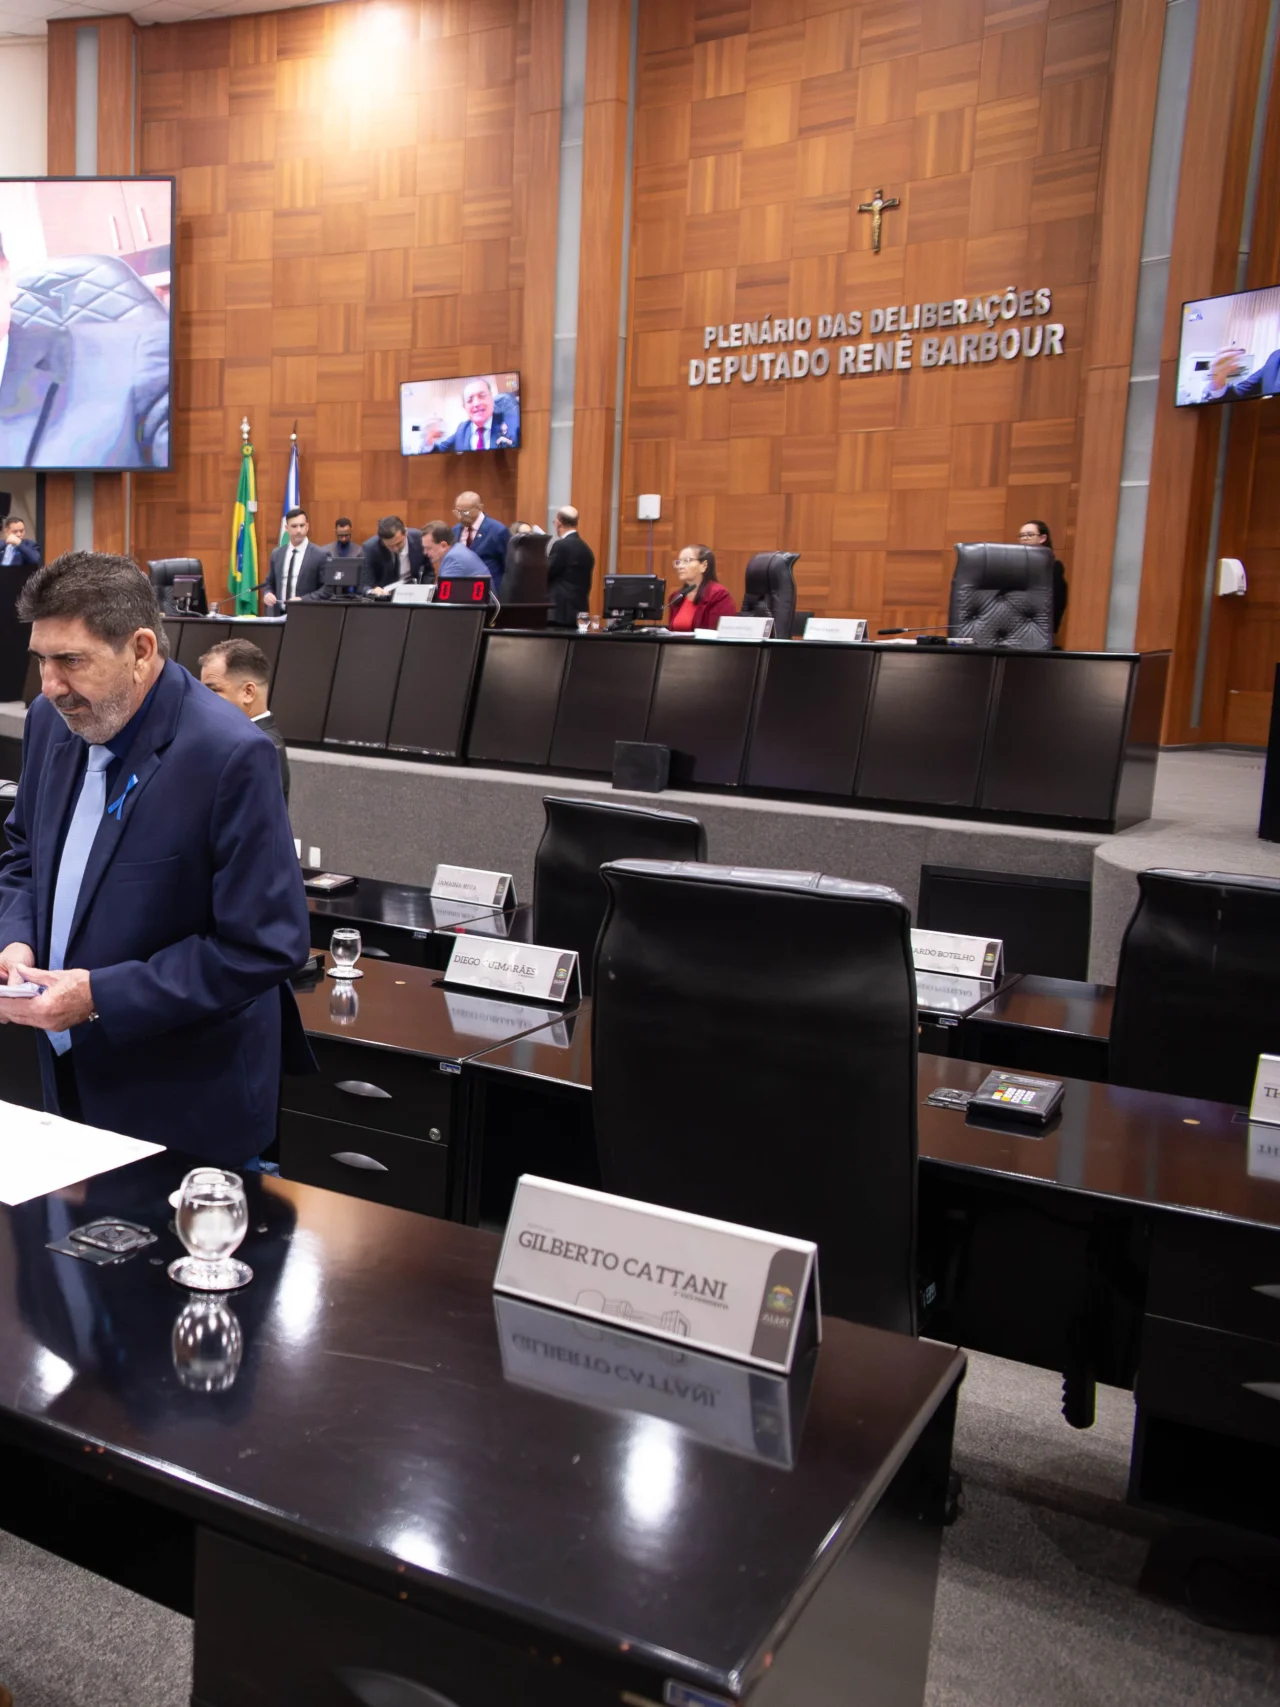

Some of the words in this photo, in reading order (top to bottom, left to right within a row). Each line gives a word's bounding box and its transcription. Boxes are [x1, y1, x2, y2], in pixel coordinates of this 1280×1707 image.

[704, 313, 812, 350] PLENÁRIO
[817, 311, 863, 340] DAS
[870, 286, 1052, 334] DELIBERAÇÕES
[688, 347, 830, 387] DEPUTADO
[838, 332, 913, 375] RENÊ
[921, 323, 1065, 368] BARBOUR
[453, 954, 480, 966] DIEGO
[913, 948, 936, 957] ARDO
[937, 950, 976, 962] BOTELHO
[518, 1230, 619, 1271] GILBERTO
[622, 1258, 729, 1301] CATTANI
